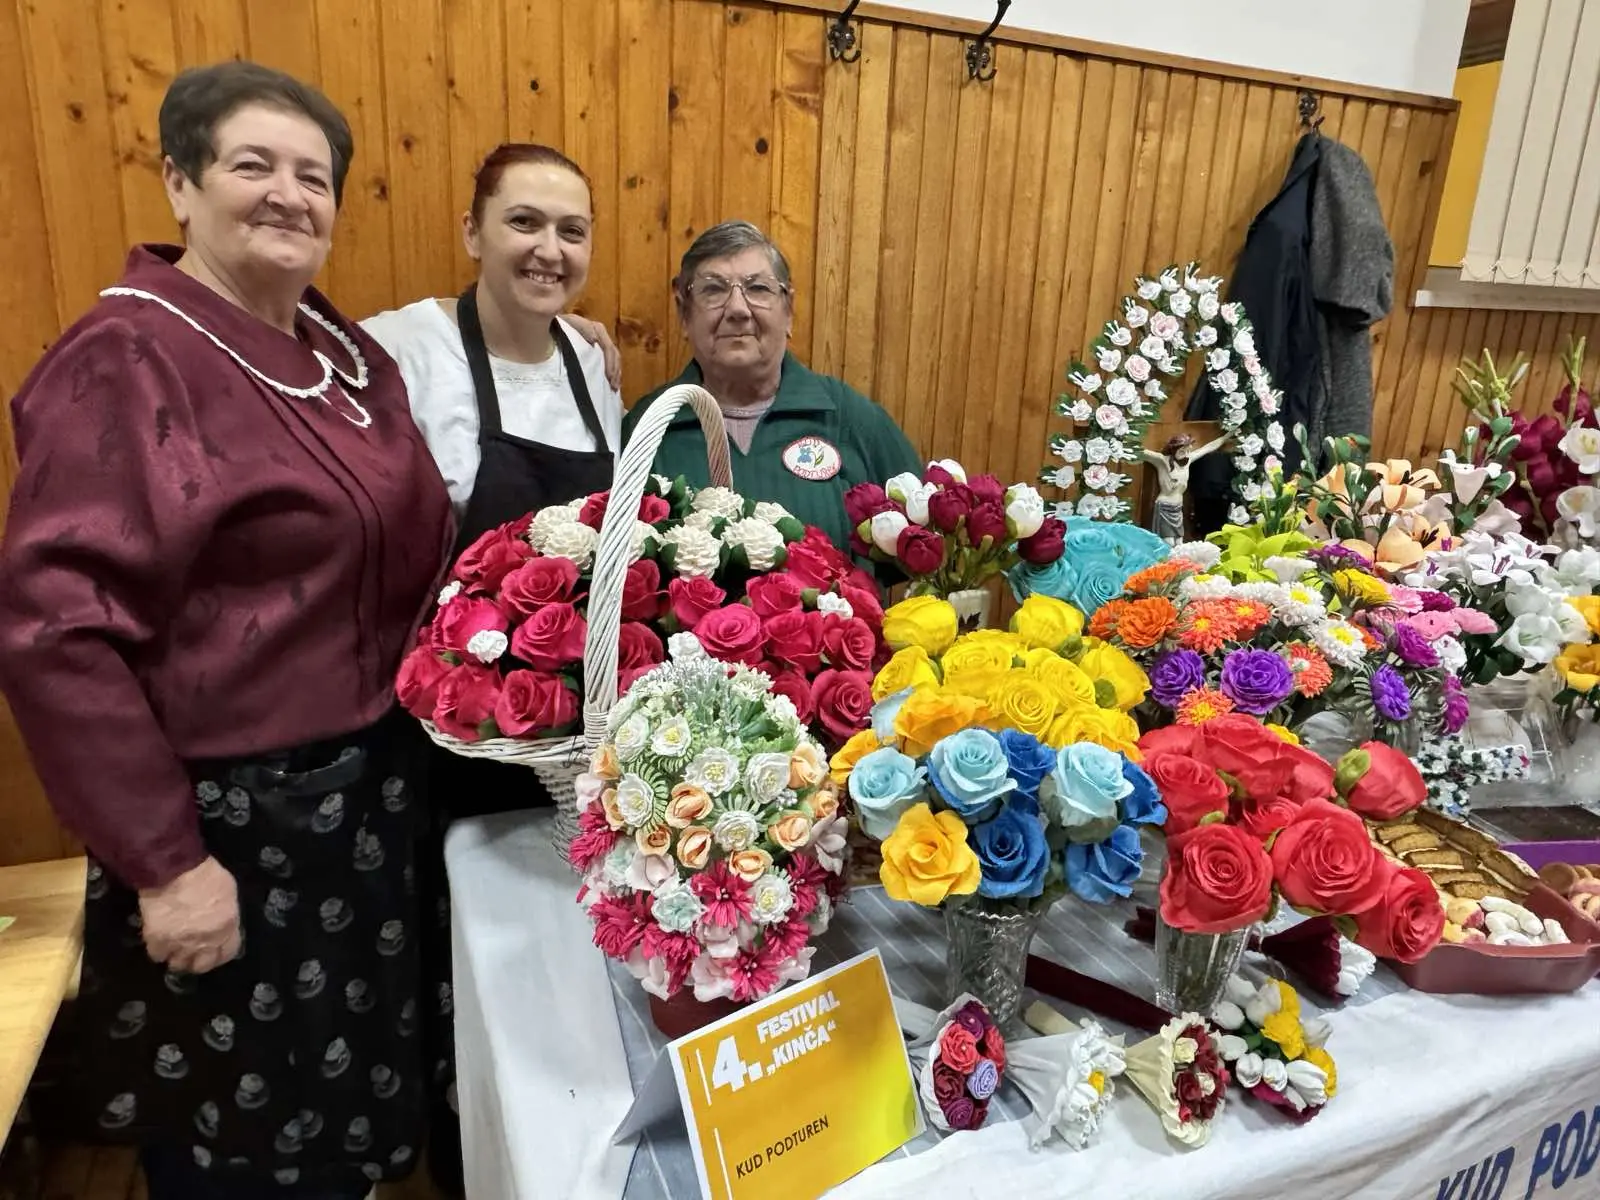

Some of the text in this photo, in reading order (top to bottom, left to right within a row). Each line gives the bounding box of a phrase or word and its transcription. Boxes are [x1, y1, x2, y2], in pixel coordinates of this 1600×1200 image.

[756, 990, 841, 1044] FESTIVAL
[711, 1035, 763, 1093] 4.
[735, 1115, 830, 1179] KUD PODTUREN
